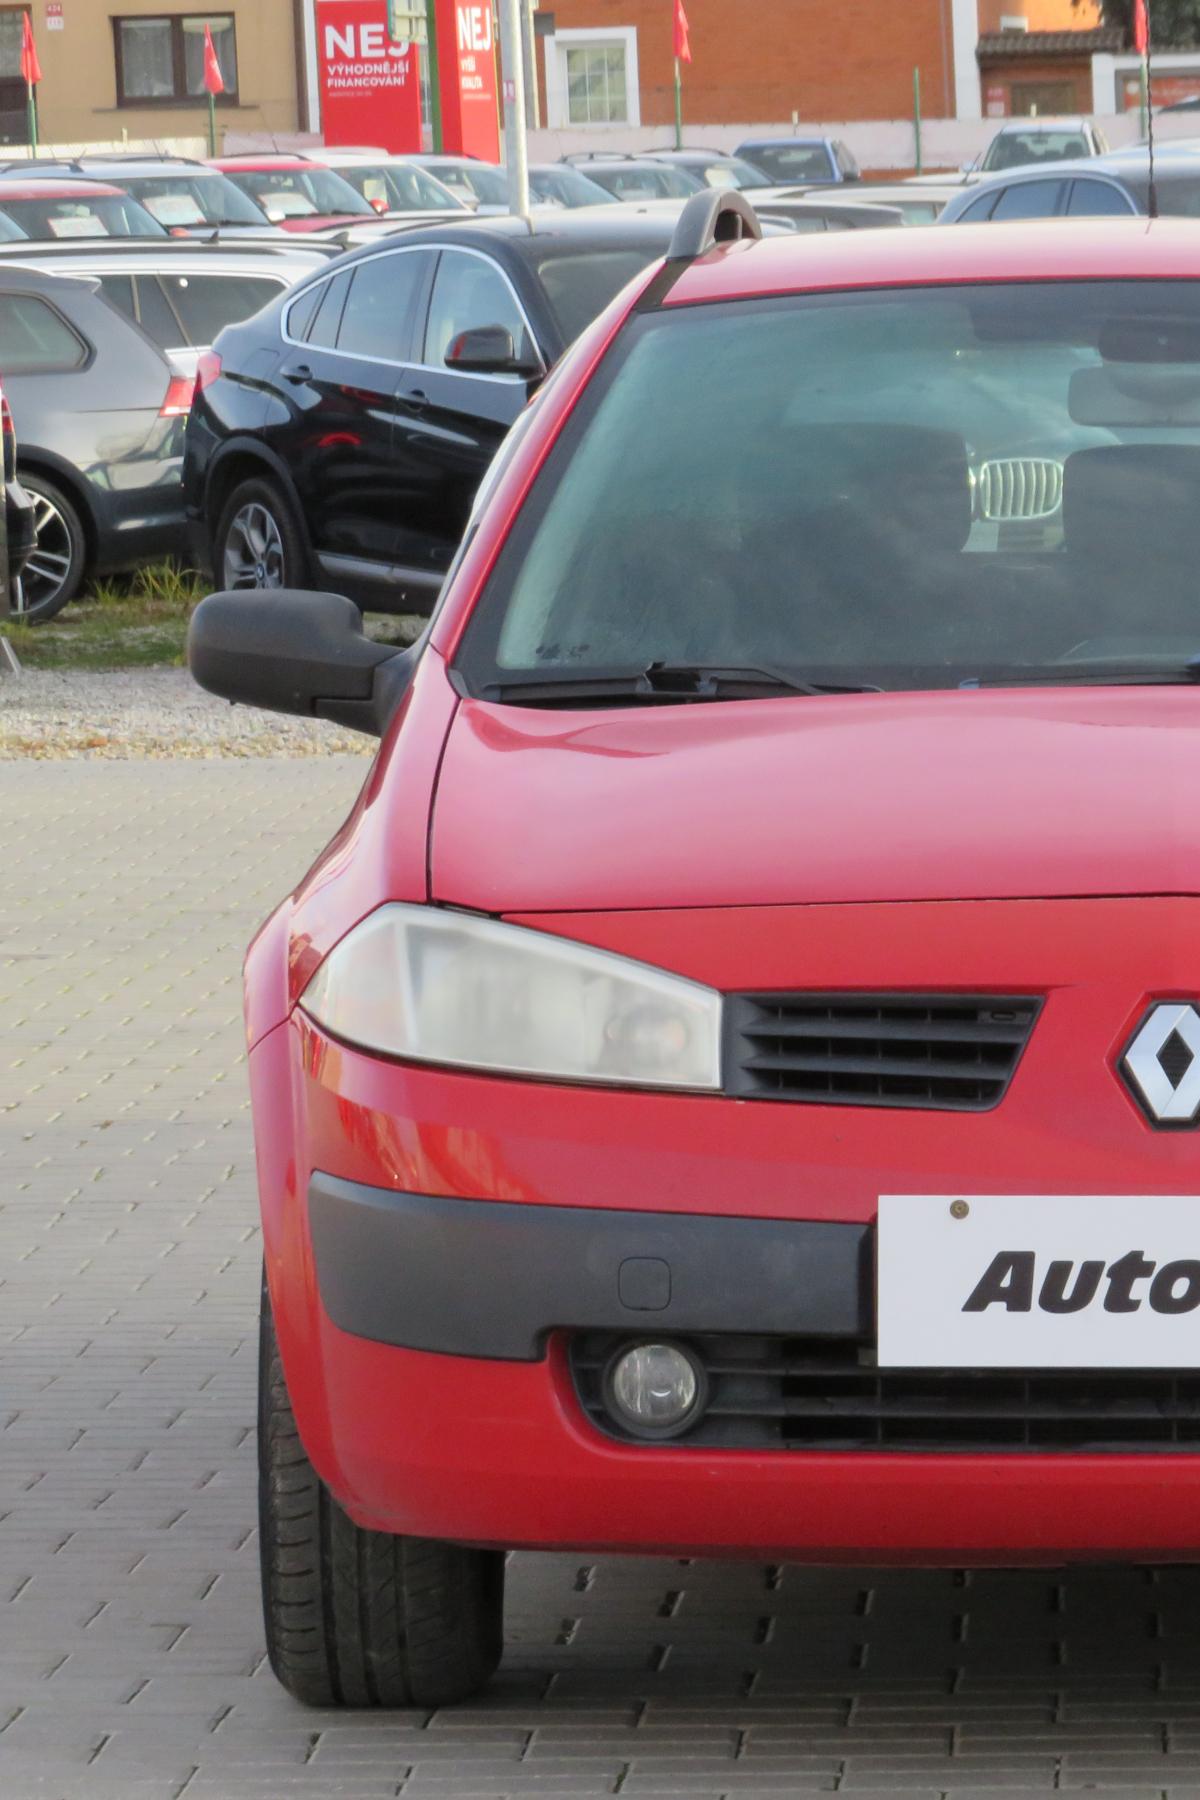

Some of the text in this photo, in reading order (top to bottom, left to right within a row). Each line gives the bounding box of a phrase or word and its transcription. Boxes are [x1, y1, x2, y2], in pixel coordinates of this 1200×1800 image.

[324, 23, 410, 59] NEJ
[457, 7, 491, 51] NEJ
[327, 60, 410, 76] VÝHODNĚJŠÍ
[327, 75, 405, 88] FINANCOVÁNÍ
